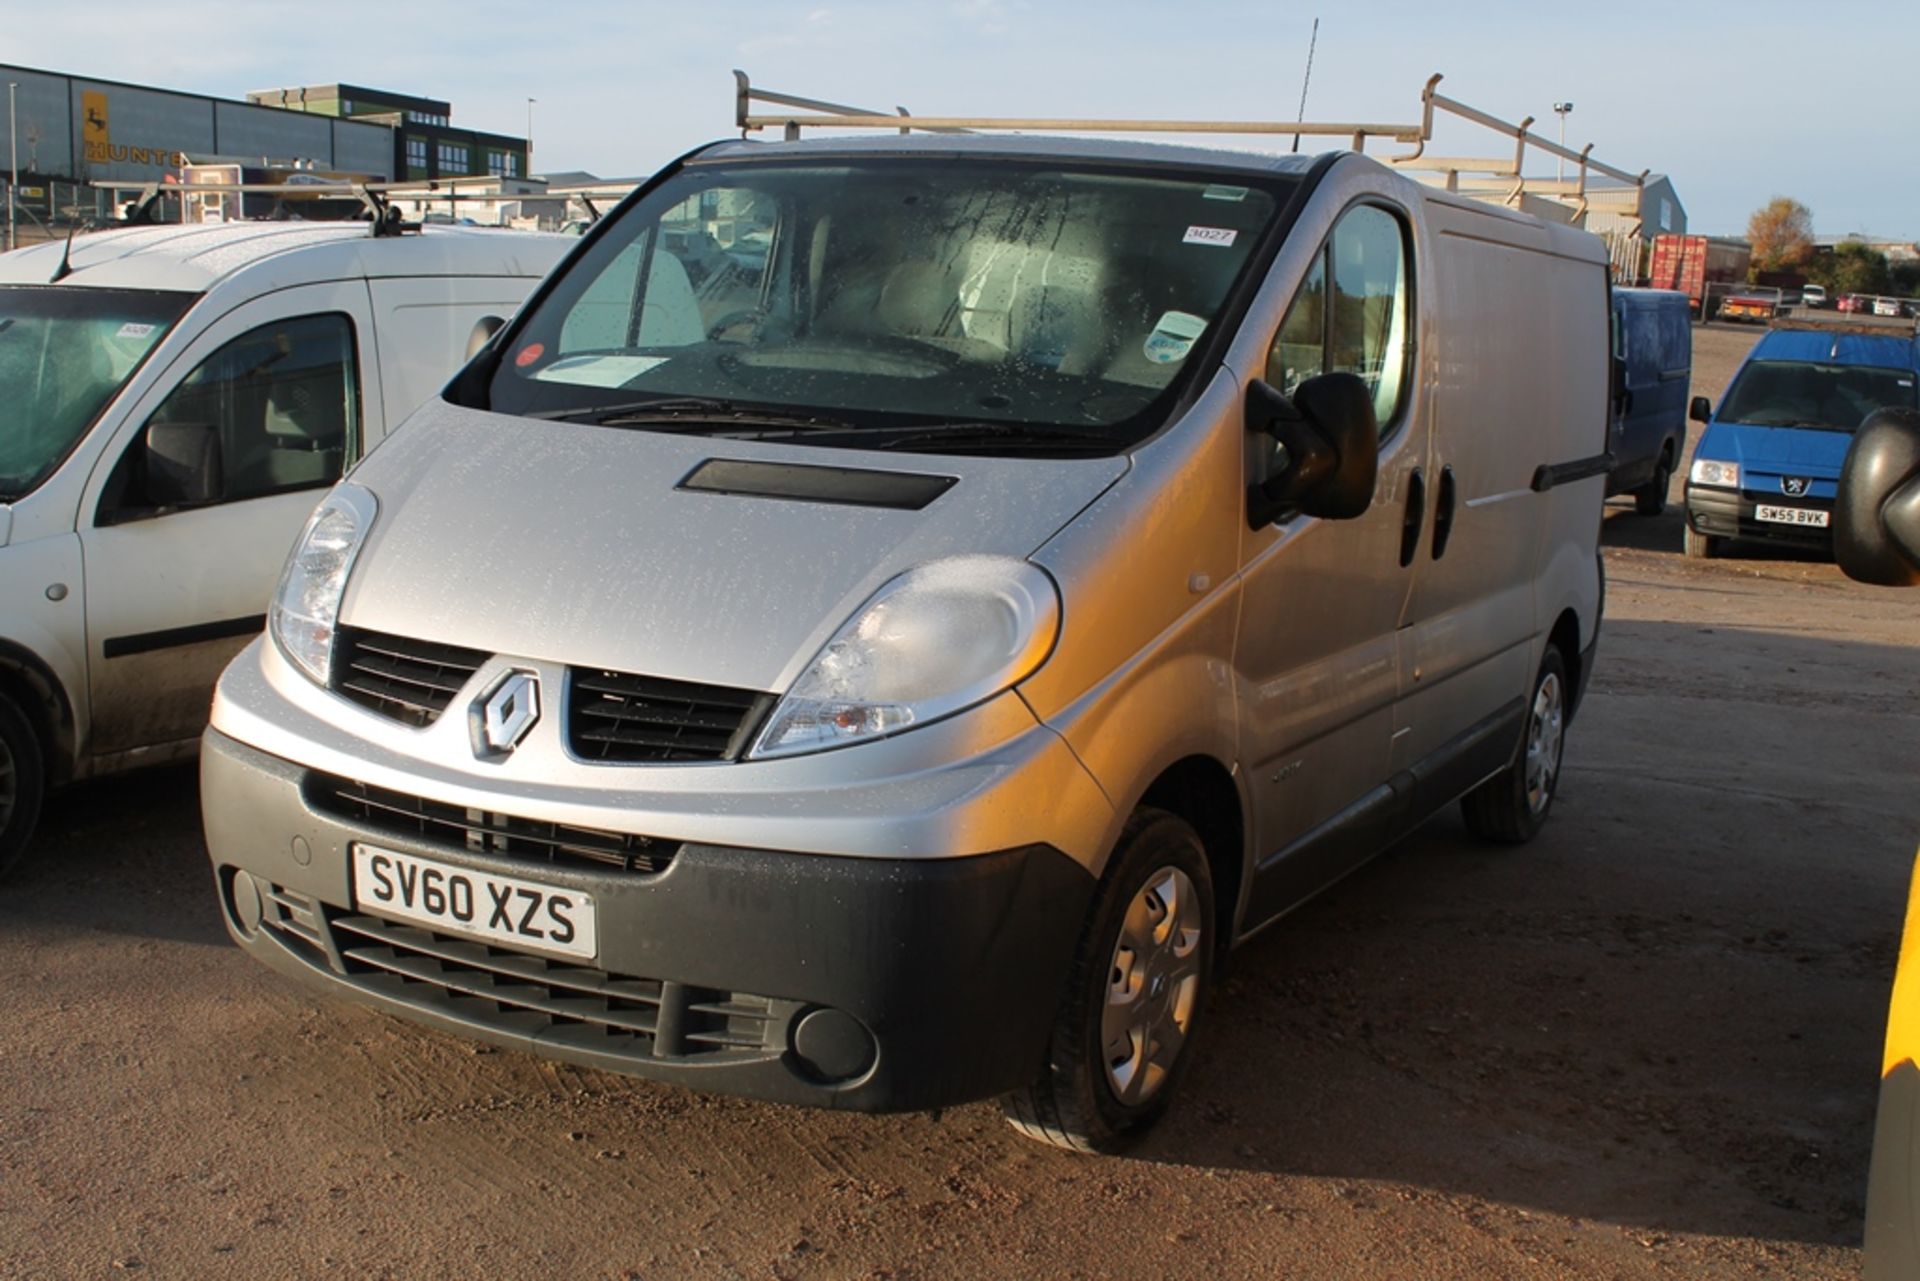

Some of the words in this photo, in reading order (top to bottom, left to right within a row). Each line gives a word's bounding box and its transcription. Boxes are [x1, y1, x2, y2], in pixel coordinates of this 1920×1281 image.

[1188, 228, 1233, 240] 3027
[1761, 507, 1795, 522] SW55
[1797, 511, 1823, 524] BVK
[370, 854, 475, 923] SV60
[487, 881, 575, 945] XZS
